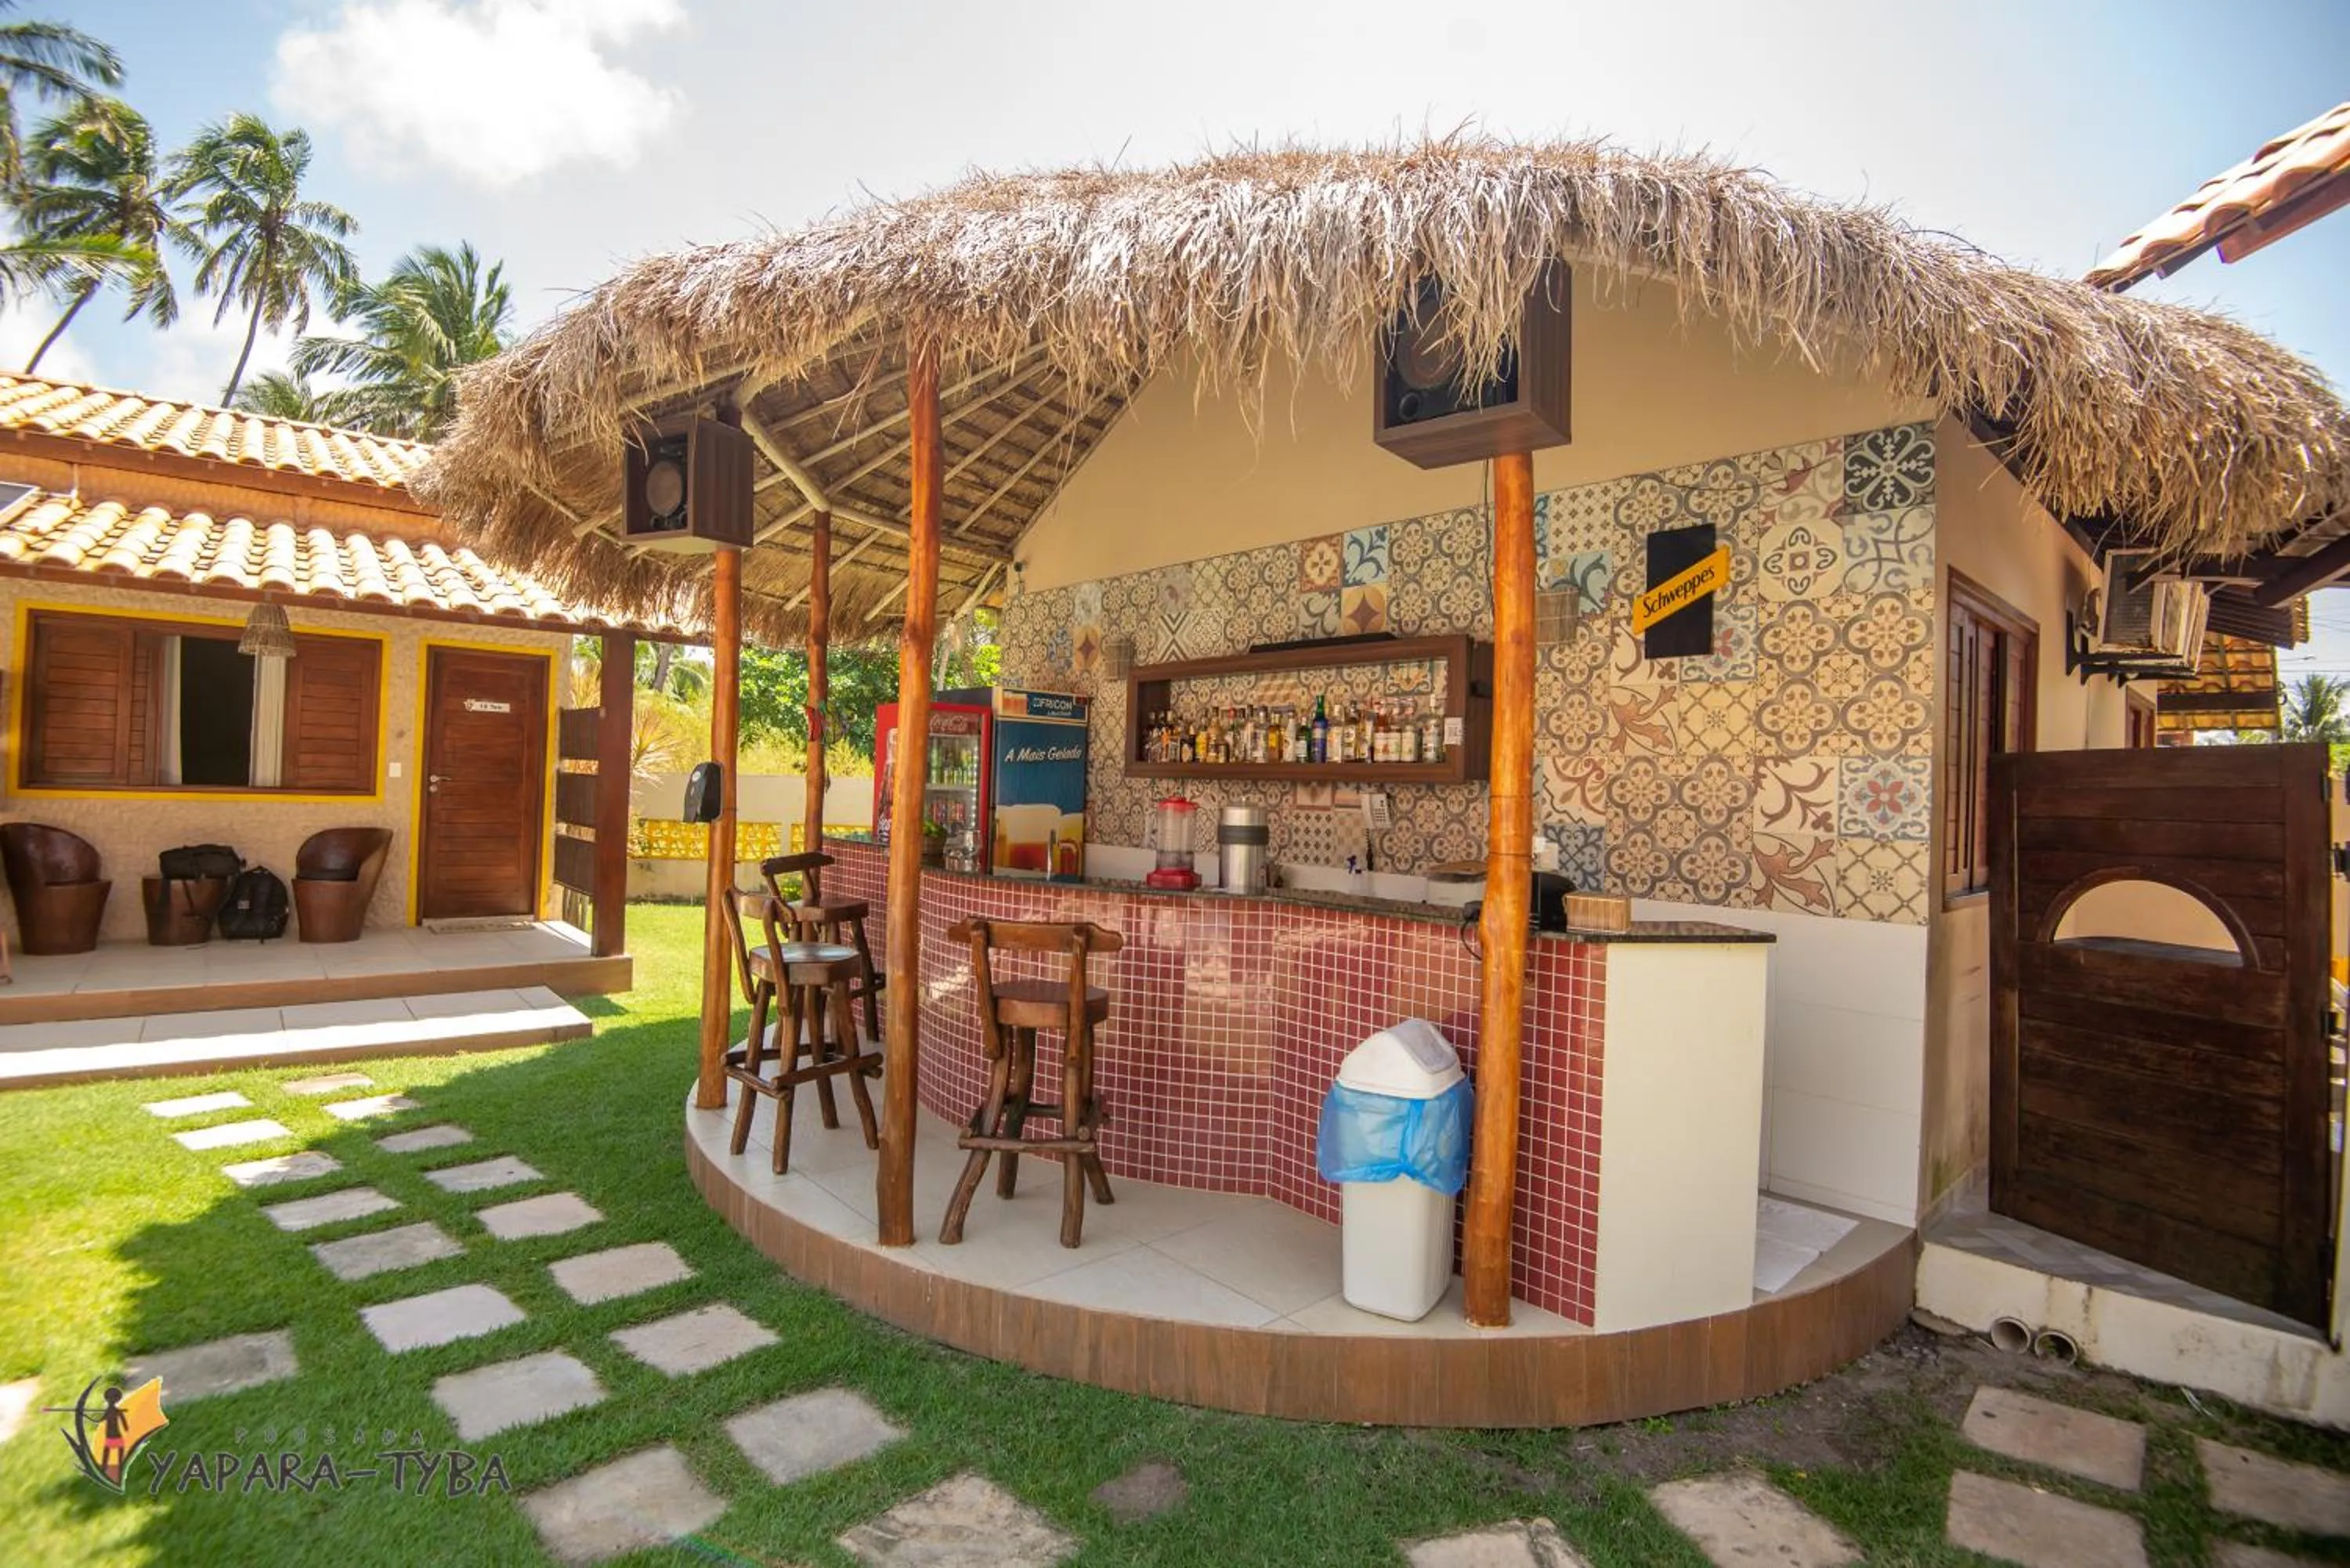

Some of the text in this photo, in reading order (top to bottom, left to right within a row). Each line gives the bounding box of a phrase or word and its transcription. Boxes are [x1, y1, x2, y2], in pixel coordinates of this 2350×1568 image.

[1643, 565, 1716, 618] Schweppes
[1004, 747, 1015, 763] A
[1017, 747, 1046, 762] Mais
